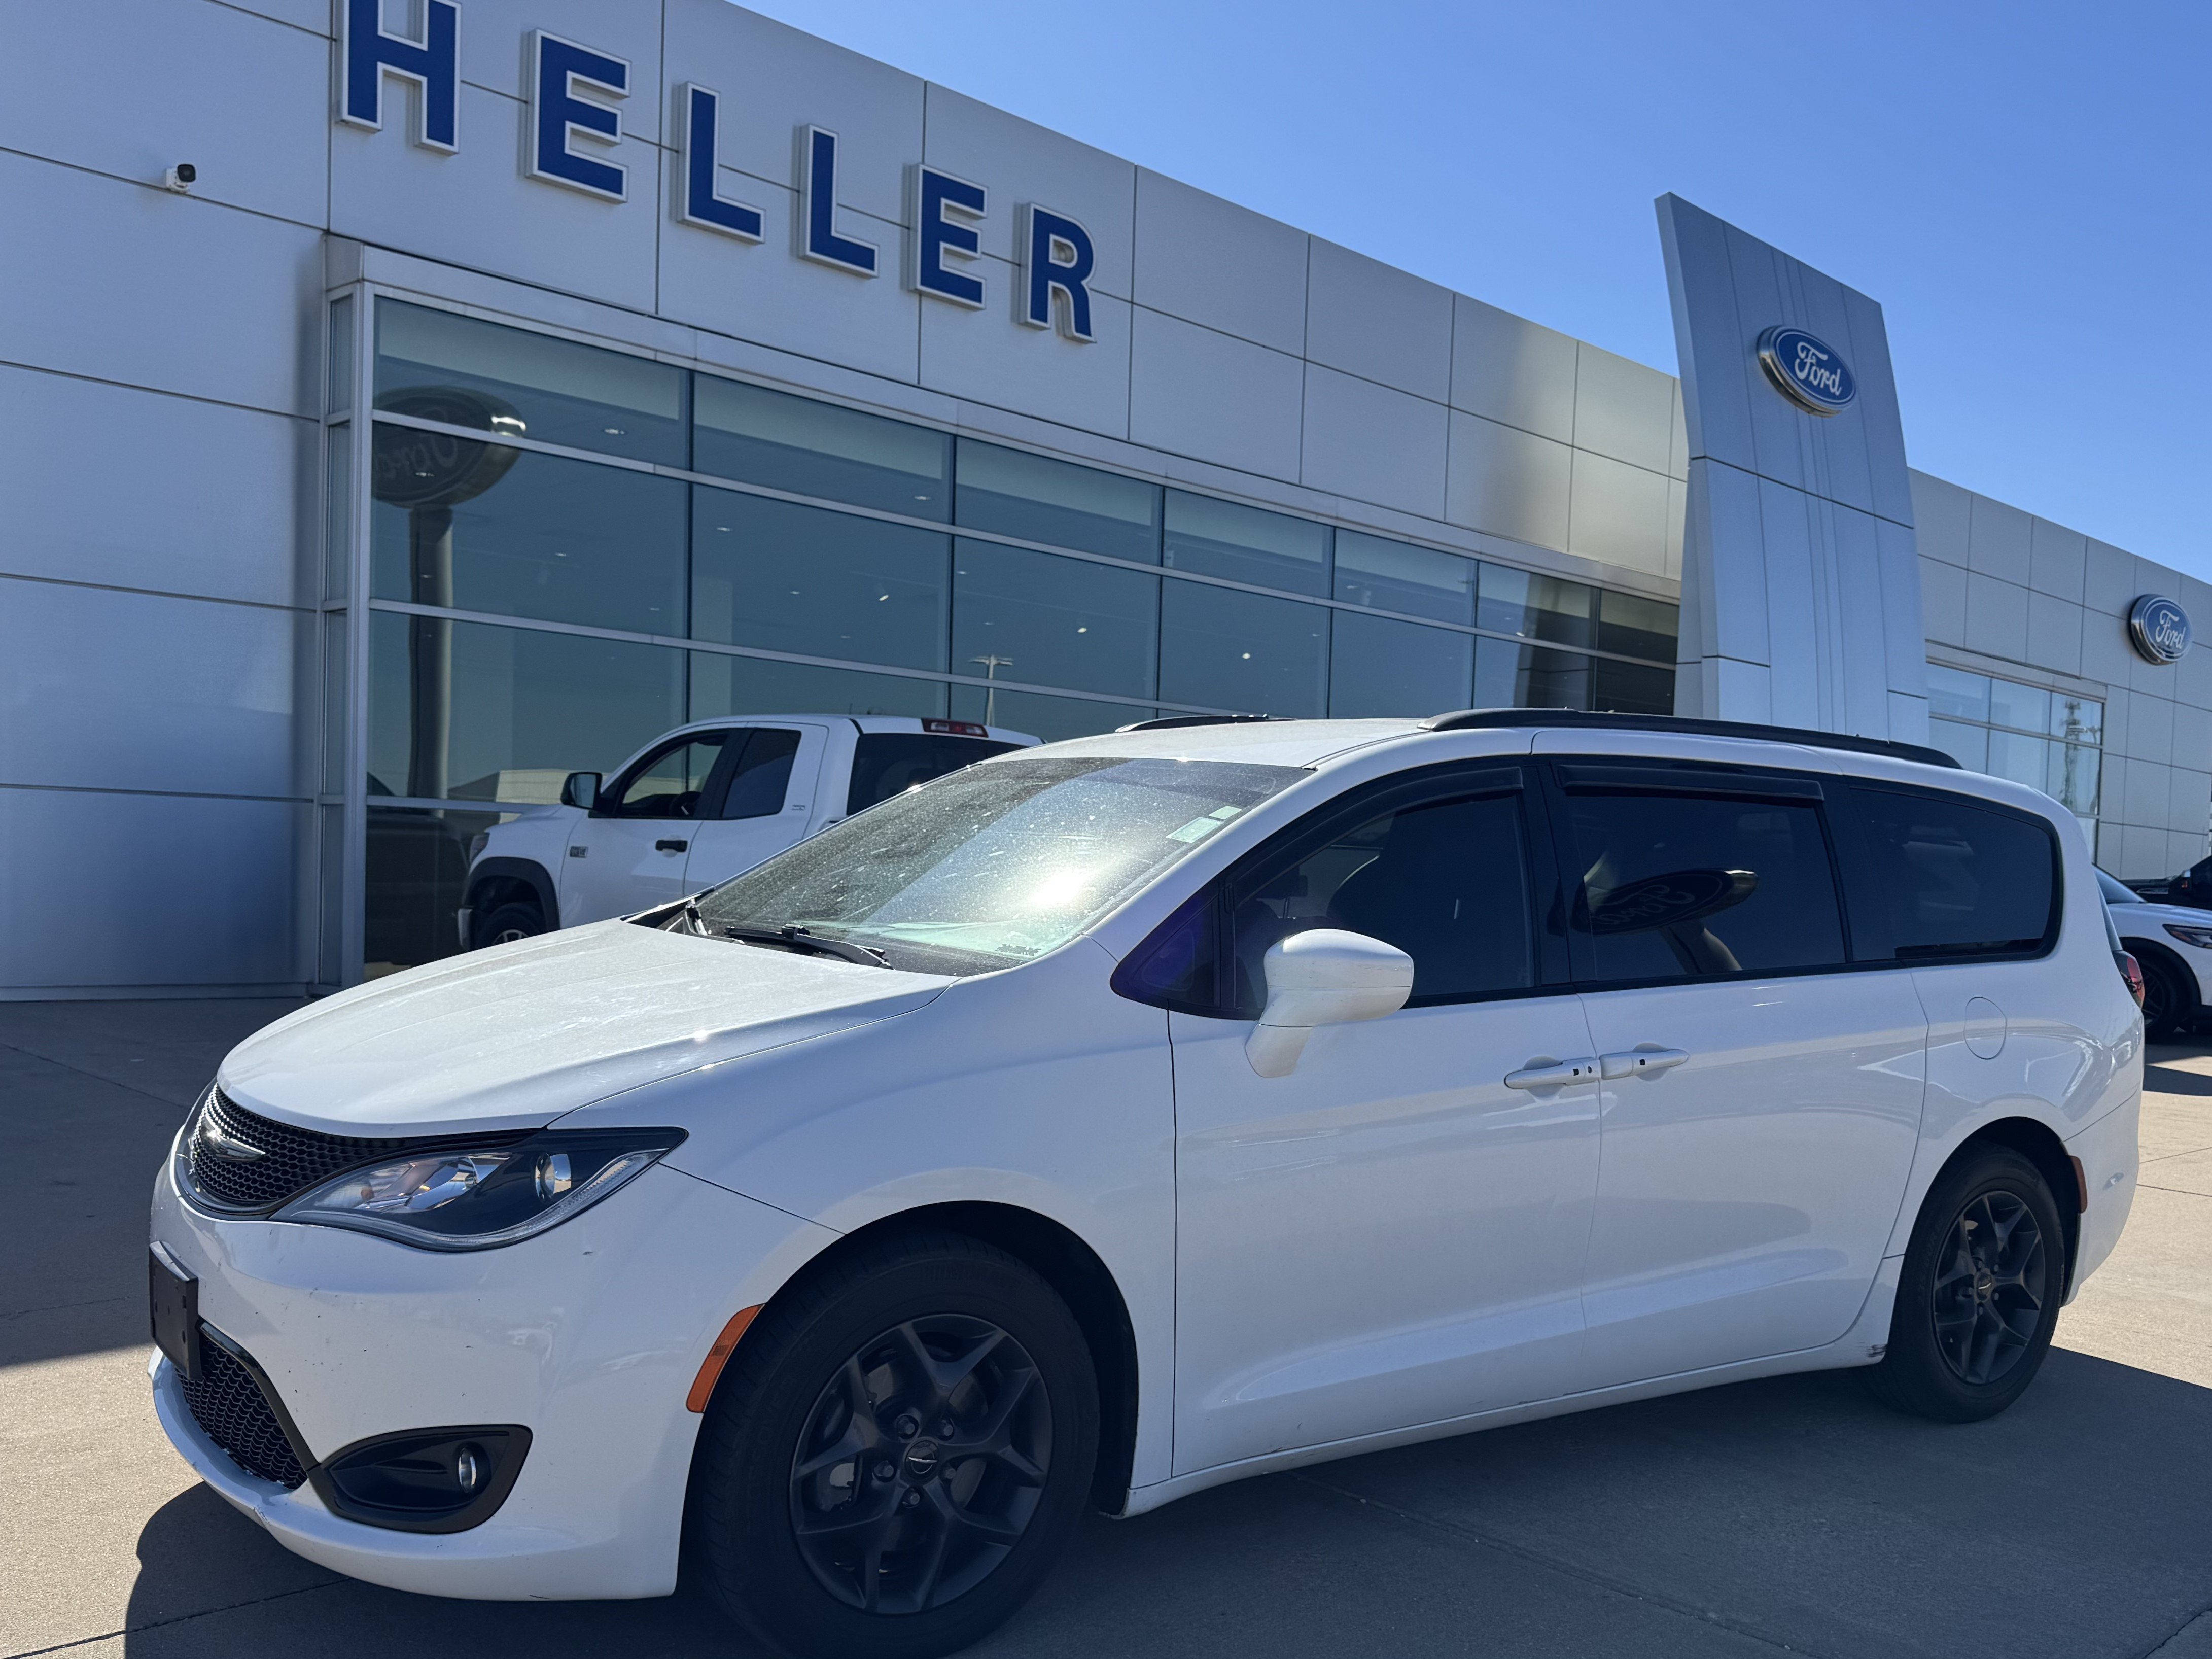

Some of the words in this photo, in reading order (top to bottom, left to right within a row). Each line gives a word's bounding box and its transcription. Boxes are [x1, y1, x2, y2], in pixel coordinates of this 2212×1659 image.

[341, 0, 1097, 344] HELLER
[1794, 341, 1842, 396] Ford
[2155, 610, 2186, 650] Ford
